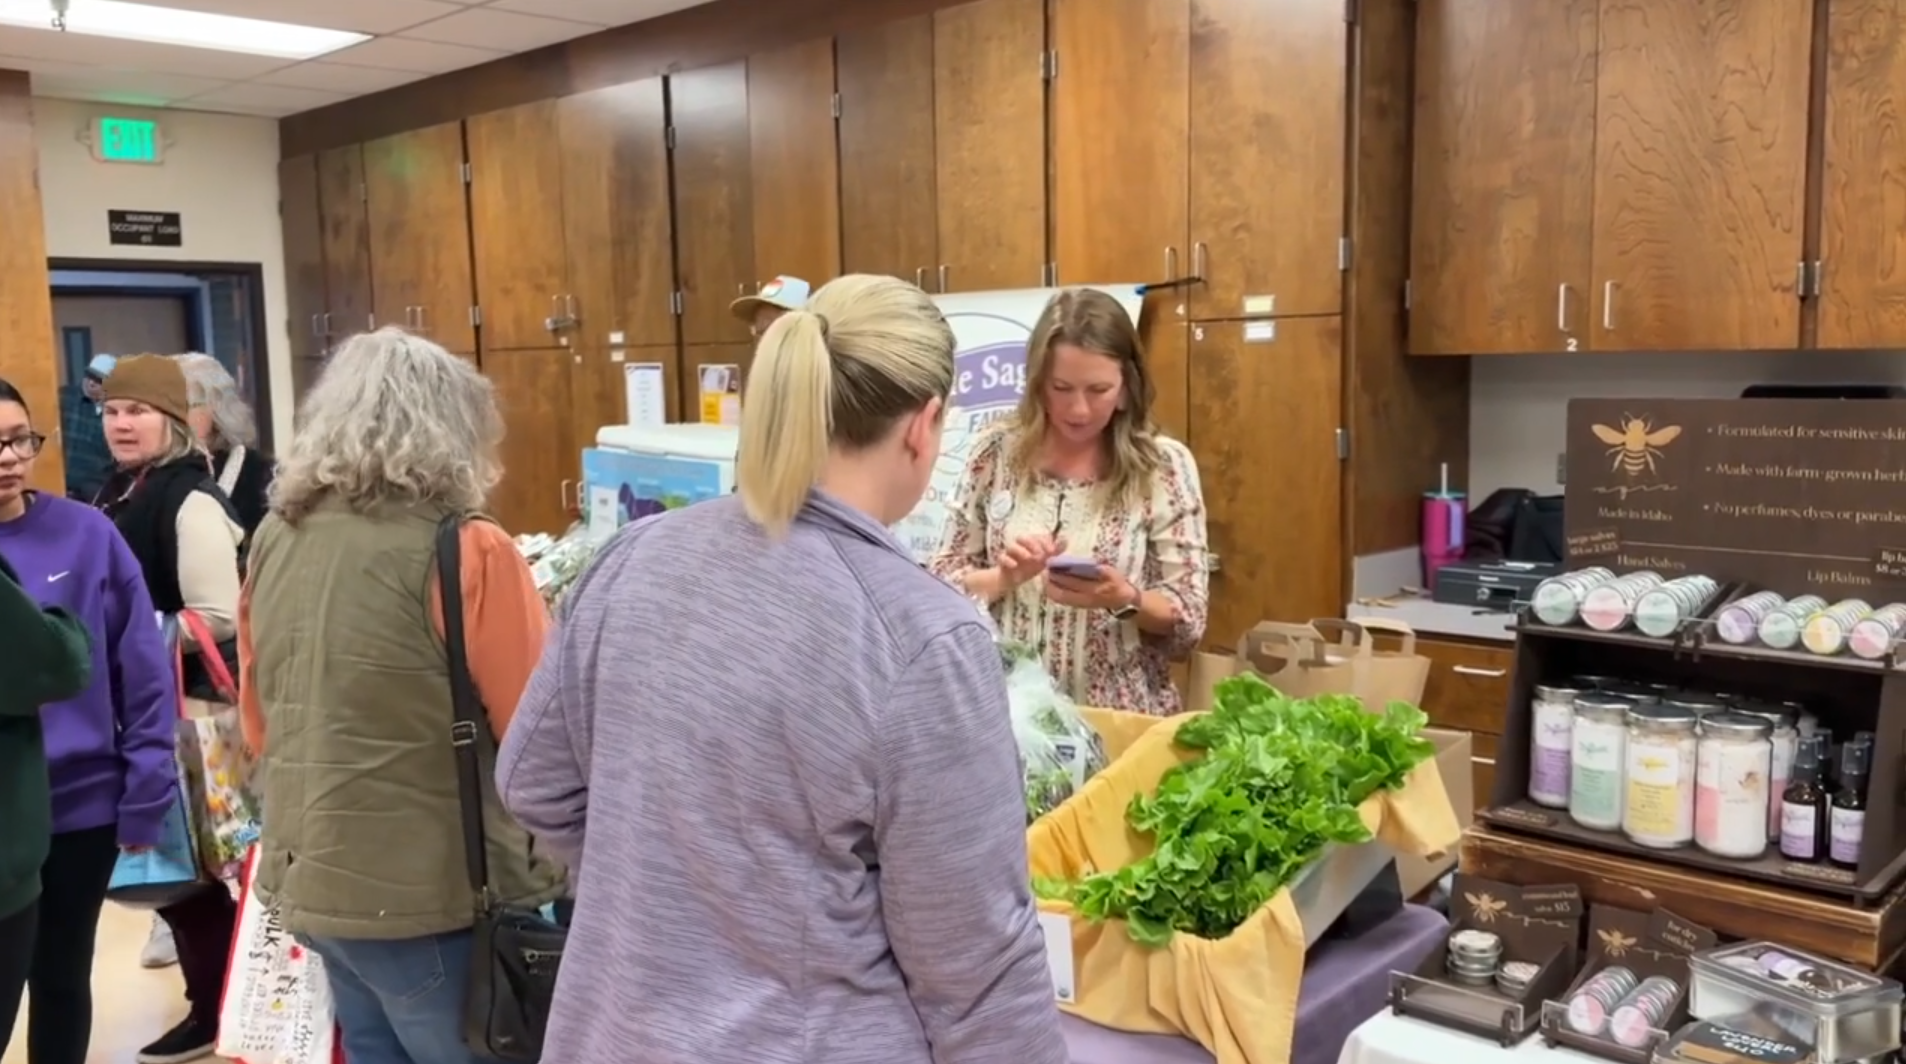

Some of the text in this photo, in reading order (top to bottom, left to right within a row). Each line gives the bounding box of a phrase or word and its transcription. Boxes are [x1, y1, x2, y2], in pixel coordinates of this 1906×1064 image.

[101, 118, 156, 161] EXIT
[125, 214, 164, 223] MAXIMUM
[111, 222, 179, 234] OCCUPANT LOAD
[1566, 337, 1579, 352] 2
[981, 354, 1028, 395] Sag
[1717, 424, 1795, 439] Formulated
[1796, 425, 1817, 438] for
[1818, 426, 1879, 440] sensitive
[1715, 463, 1751, 477] Made
[1754, 464, 1784, 478] with
[1598, 506, 1673, 521] Made in Idaho
[1713, 501, 1733, 514] No
[1802, 505, 1835, 521] dyes
[1836, 509, 1853, 520] or
[1617, 554, 1686, 570] Hand Salves
[1807, 569, 1872, 585] Lip Balms
[1667, 920, 1681, 933] for
[1709, 1027, 1797, 1054] LAVENDER
